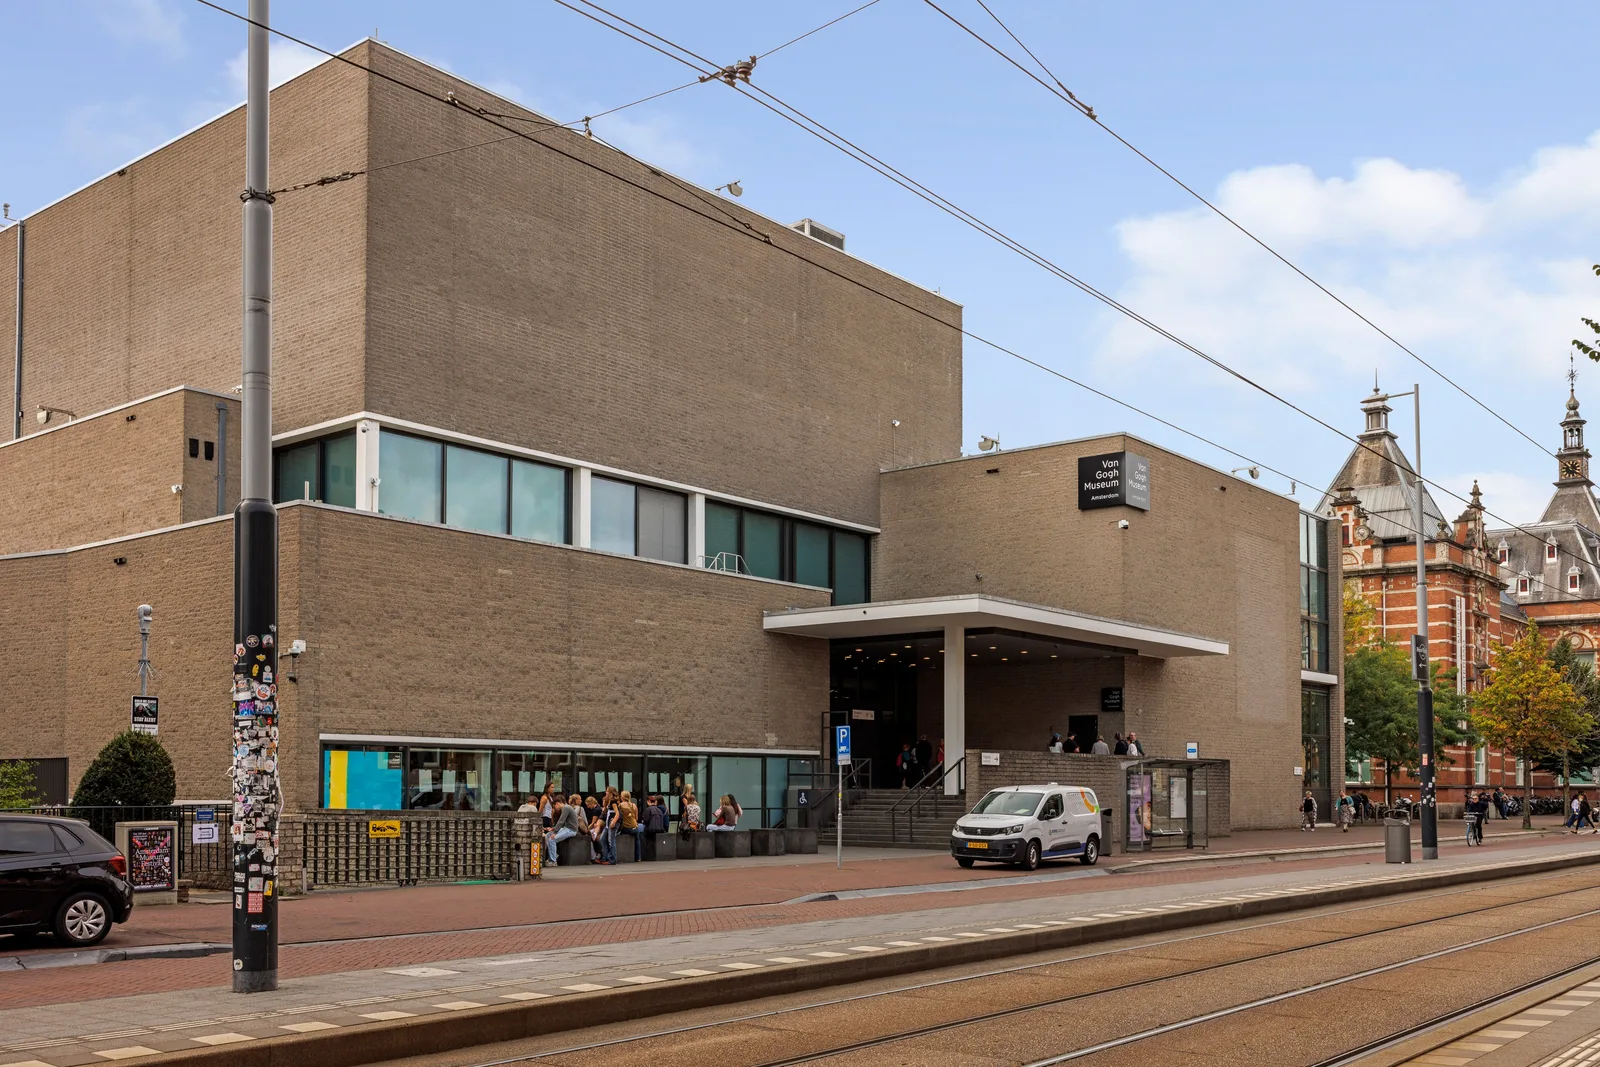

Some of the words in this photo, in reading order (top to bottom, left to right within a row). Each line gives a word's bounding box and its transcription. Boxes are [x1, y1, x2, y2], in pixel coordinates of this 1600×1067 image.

[1102, 460, 1119, 468] Van
[1138, 462, 1146, 472] Van
[1096, 469, 1119, 479] Gogh
[1134, 470, 1146, 482] Gogh
[1084, 480, 1119, 490] Museum
[1128, 478, 1146, 492] Museum
[840, 728, 847, 743] P
